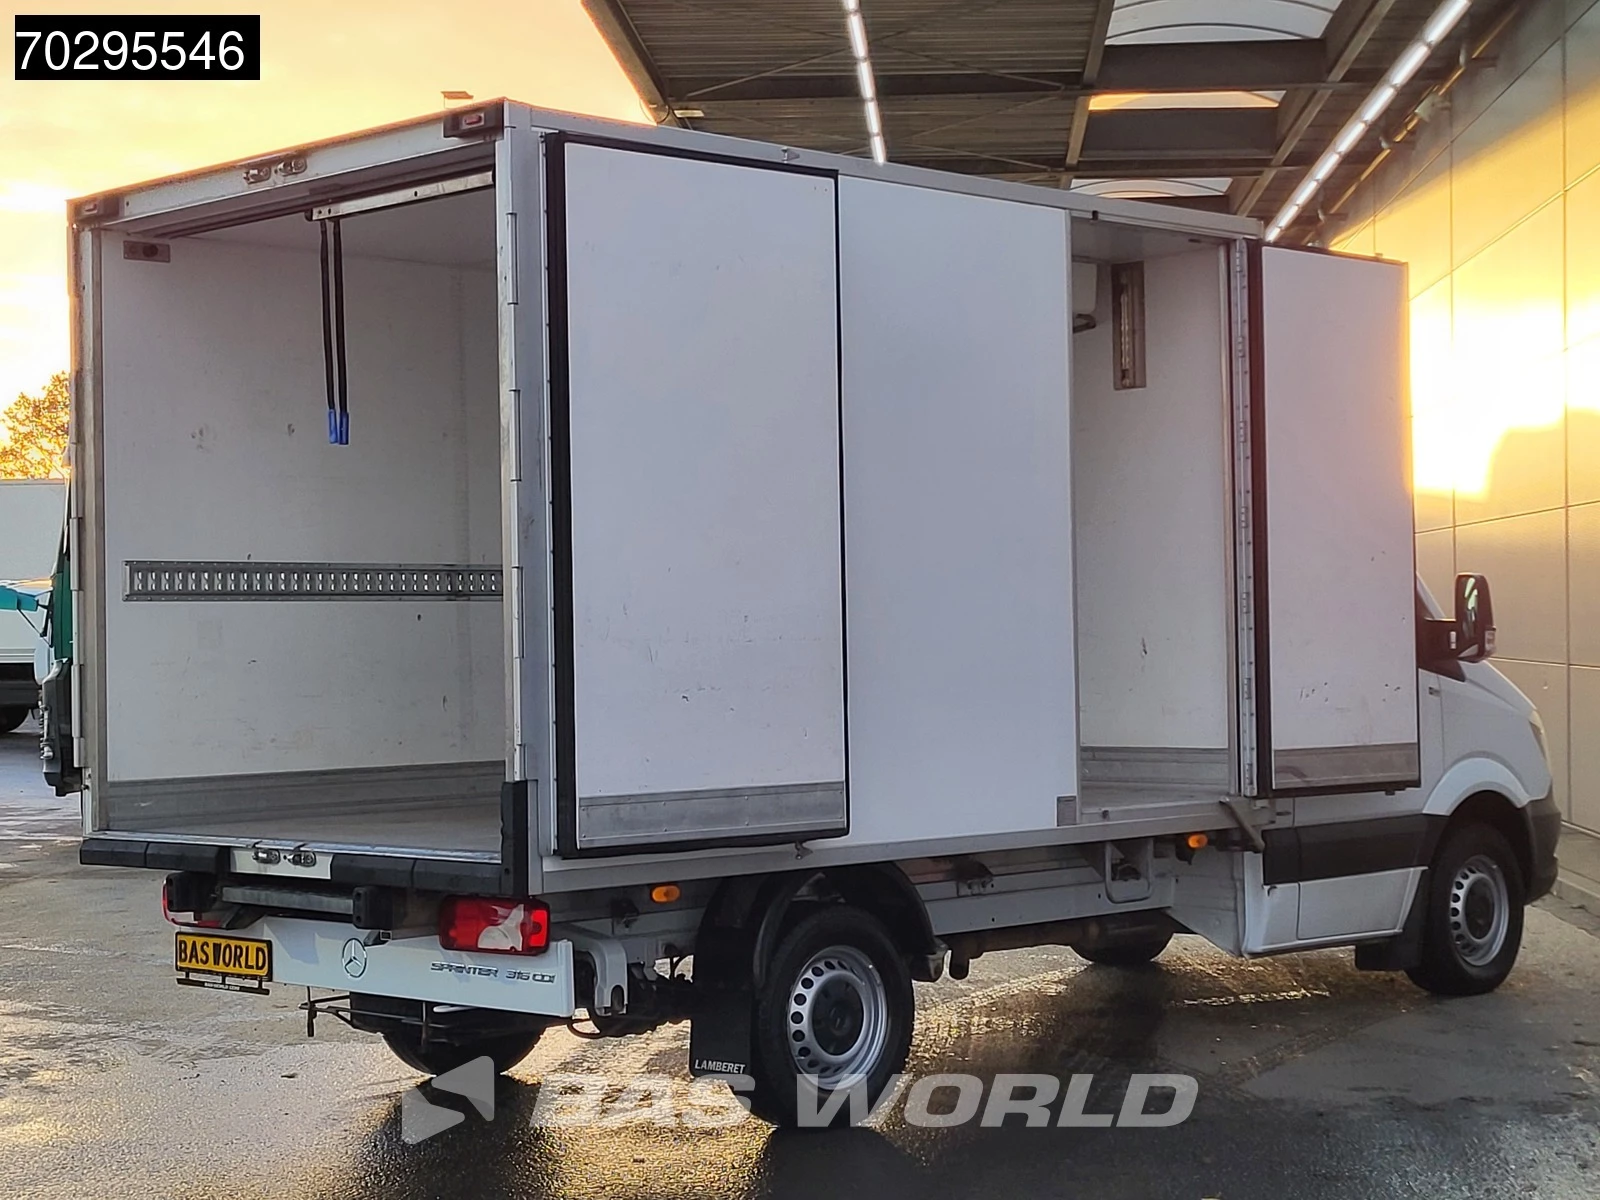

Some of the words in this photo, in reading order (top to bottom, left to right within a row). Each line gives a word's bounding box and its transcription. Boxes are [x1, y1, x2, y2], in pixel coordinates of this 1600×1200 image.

[430, 961, 498, 977] SPRINTER
[505, 969, 531, 980] 316
[532, 973, 556, 983] CDI
[694, 1059, 746, 1074] LAMBERET
